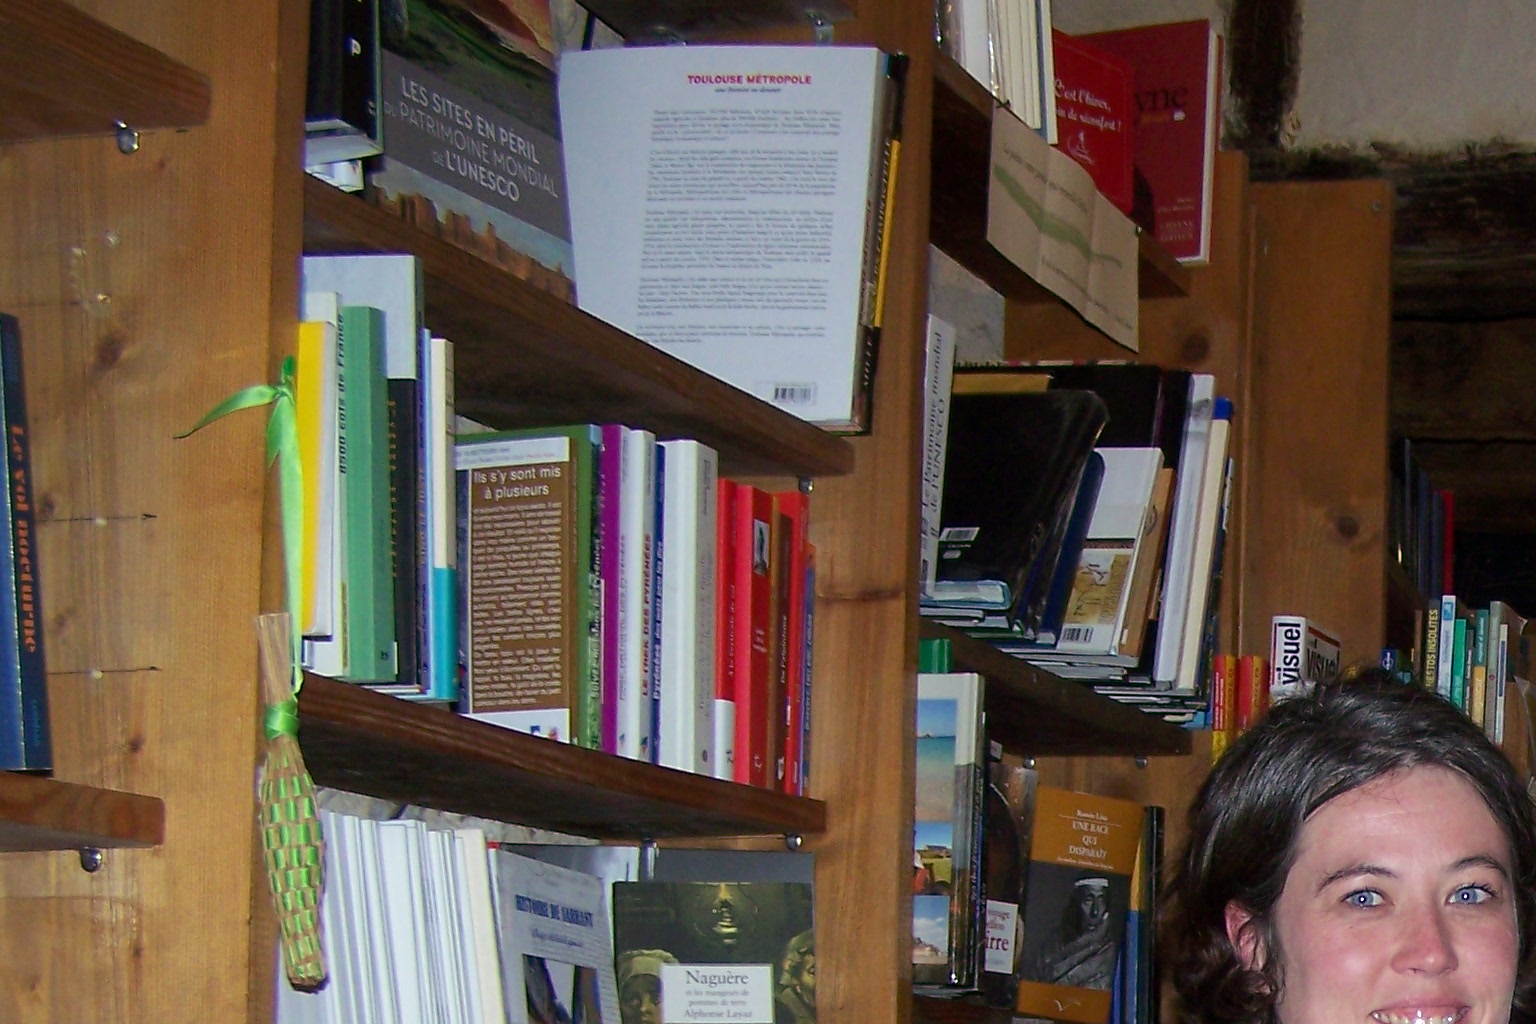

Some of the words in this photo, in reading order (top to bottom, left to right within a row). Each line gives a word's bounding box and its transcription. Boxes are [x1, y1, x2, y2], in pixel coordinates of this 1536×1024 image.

[687, 75, 743, 84] TOULOUSE
[746, 73, 812, 84] MÉTROPOLE
[401, 77, 429, 107] LES
[432, 92, 473, 130] SITES
[476, 115, 495, 143] EN
[499, 128, 540, 164] PÉRIL
[399, 102, 490, 164] PATRIMOINE
[493, 151, 559, 199] MONDIAL
[445, 150, 521, 202] L'UNESCO
[337, 314, 345, 367] France
[337, 380, 345, 393] de
[10, 425, 24, 462] Le
[339, 435, 347, 474] 8500
[13, 469, 30, 511] vol
[473, 471, 487, 484] Ils
[491, 470, 507, 485] s'y
[510, 468, 536, 480] sont
[540, 466, 561, 478] mis
[484, 487, 492, 500] à
[495, 484, 549, 501] plusieurs
[17, 519, 37, 654] nocturne
[1276, 623, 1301, 685] visuel
[1082, 835, 1098, 846] QUI
[686, 970, 749, 988] Naguère
